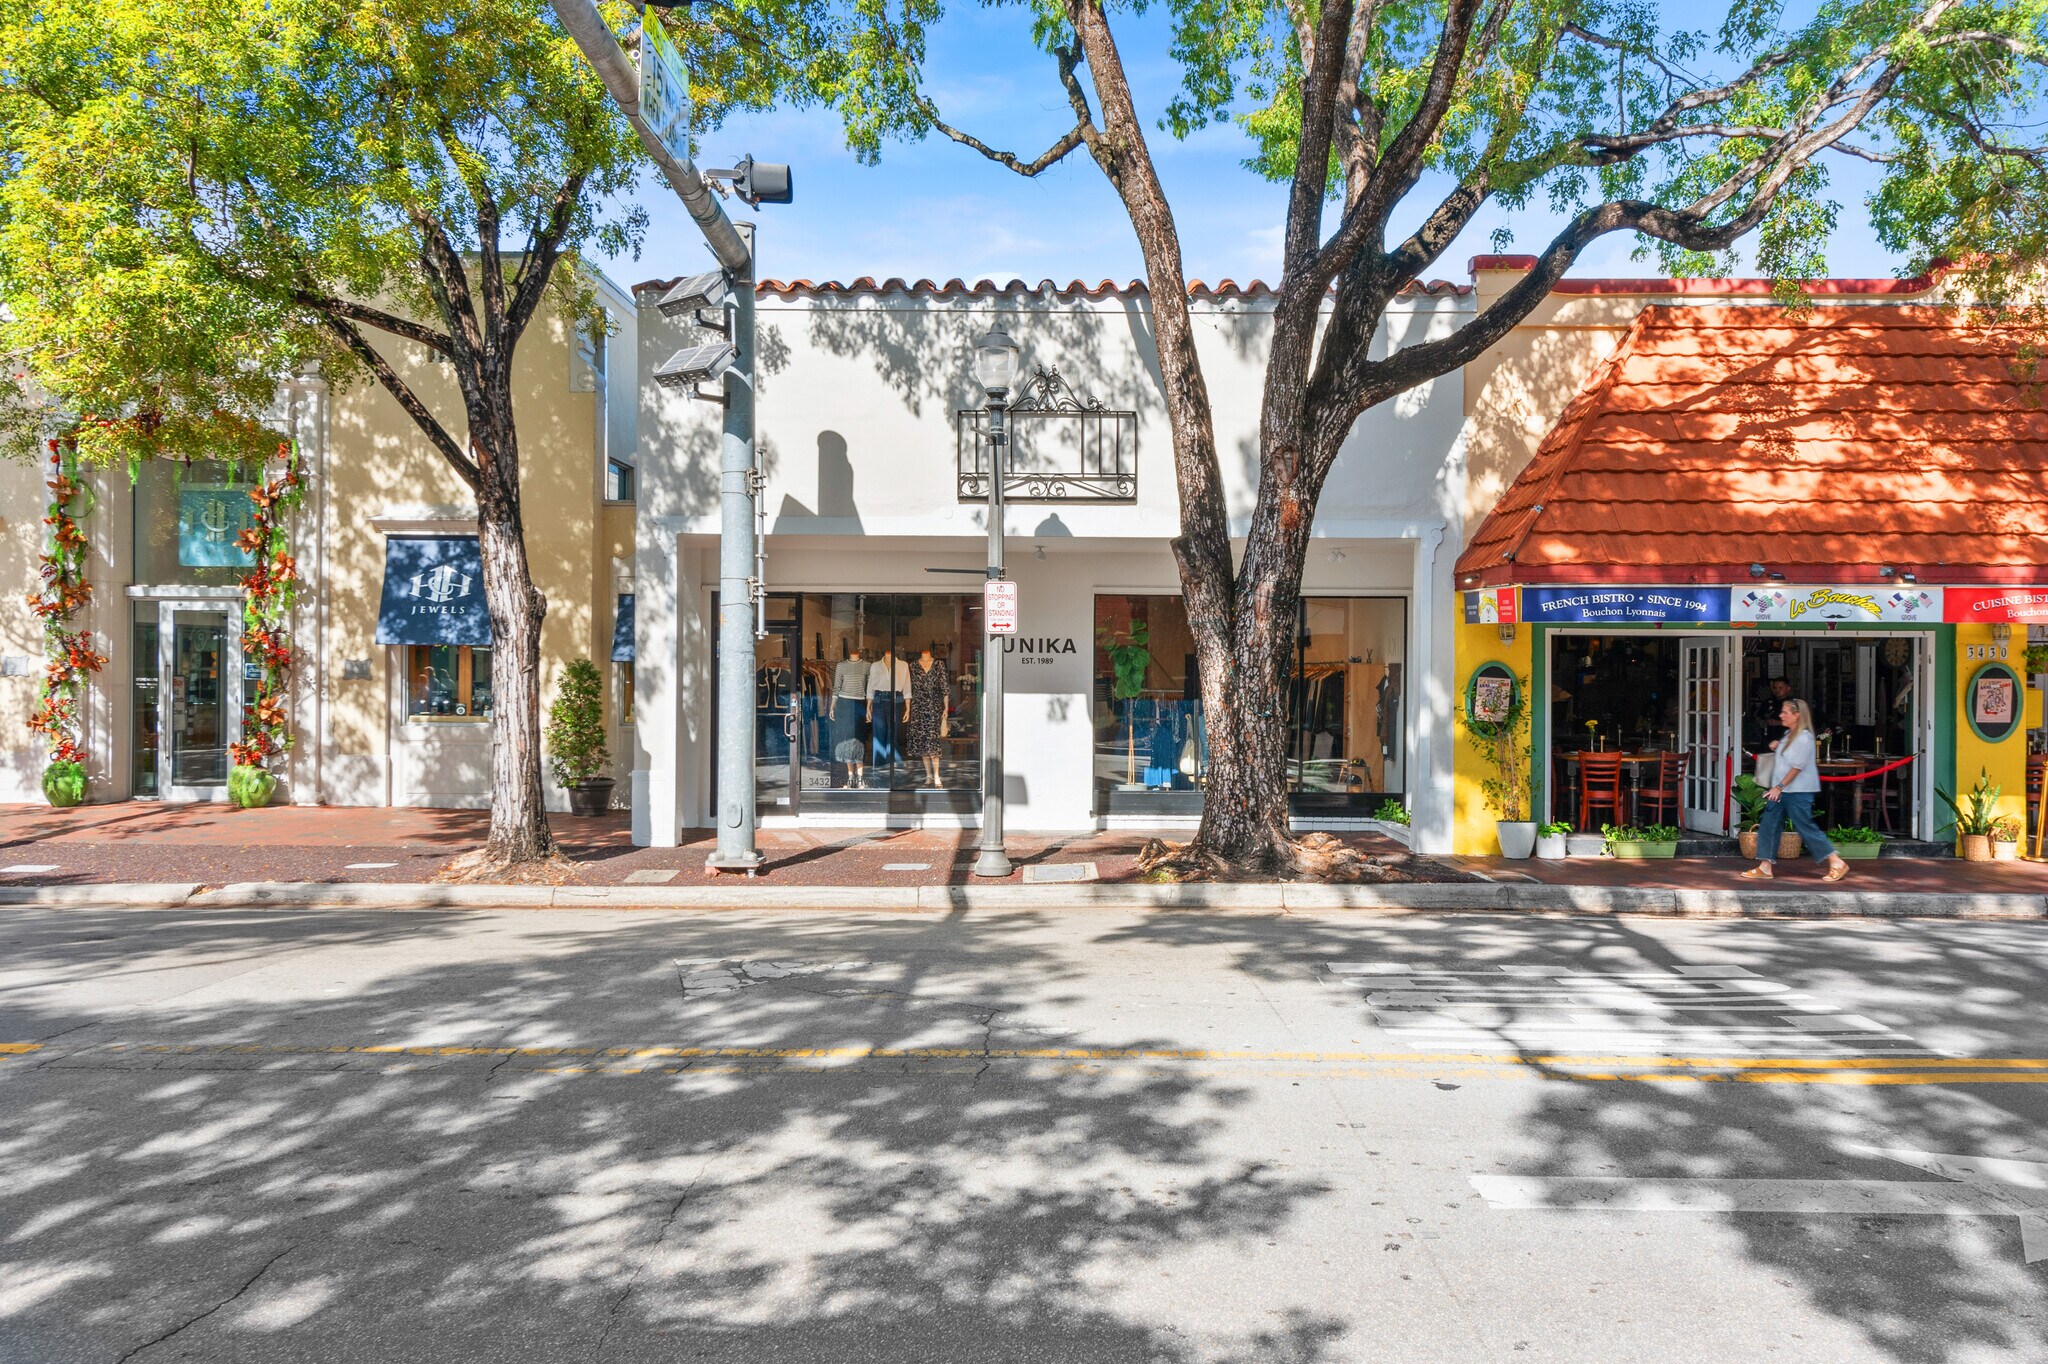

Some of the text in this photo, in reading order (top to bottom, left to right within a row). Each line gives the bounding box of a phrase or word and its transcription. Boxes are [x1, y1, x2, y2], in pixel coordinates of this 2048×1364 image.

[652, 54, 663, 97] 15
[411, 605, 466, 615] JEWELS
[1541, 594, 1707, 613] FRENCH BISTRO SINCE 1994
[1790, 588, 1883, 620] Le Bouchon
[1973, 596, 2022, 611] CUISINE
[1582, 607, 1666, 618] Bouchon Lyonnais
[2007, 607, 2048, 619] Bouchon
[1003, 638, 1077, 653] UNIKA
[1968, 647, 2007, 658] 3430
[809, 777, 830, 786] 3432
